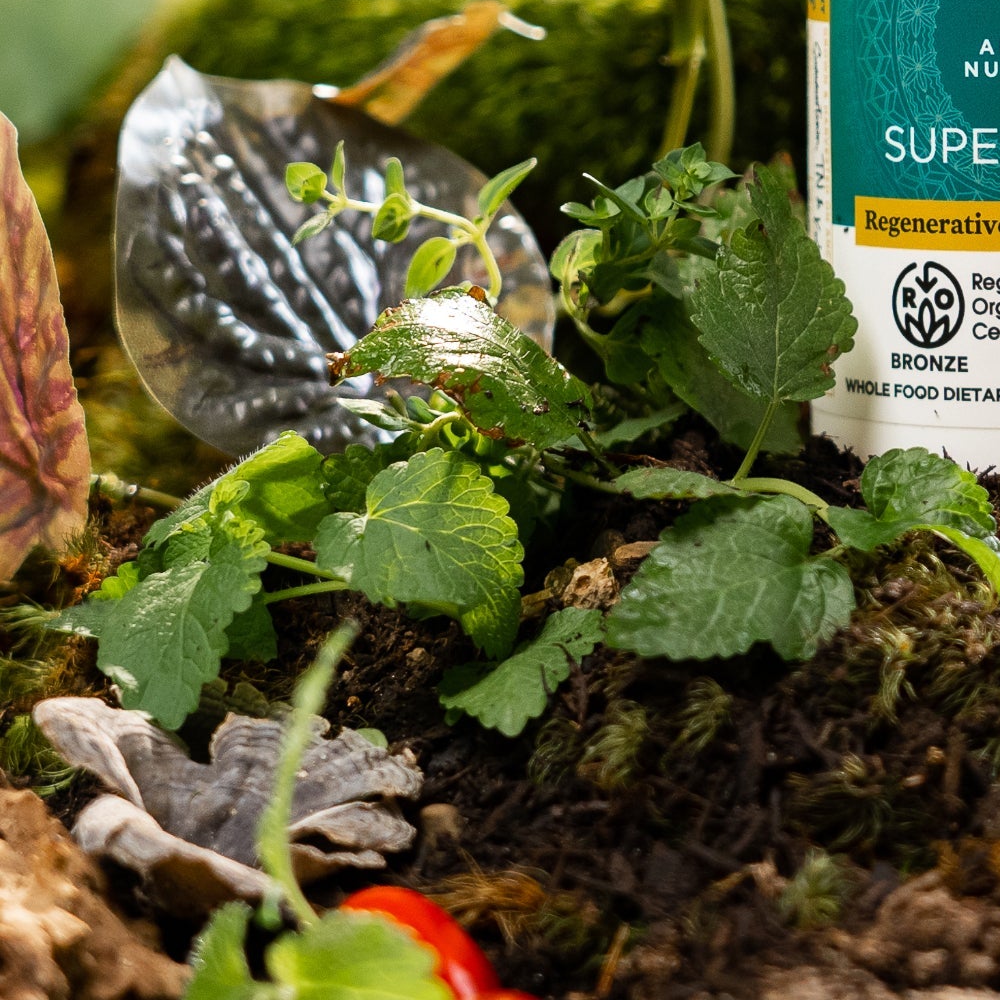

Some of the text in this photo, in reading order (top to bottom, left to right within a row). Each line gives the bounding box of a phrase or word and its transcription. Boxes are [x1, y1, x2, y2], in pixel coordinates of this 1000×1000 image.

[891, 352, 969, 373] BRONZE
[845, 377, 891, 397] WHOLE
[894, 383, 940, 401] FOOD
